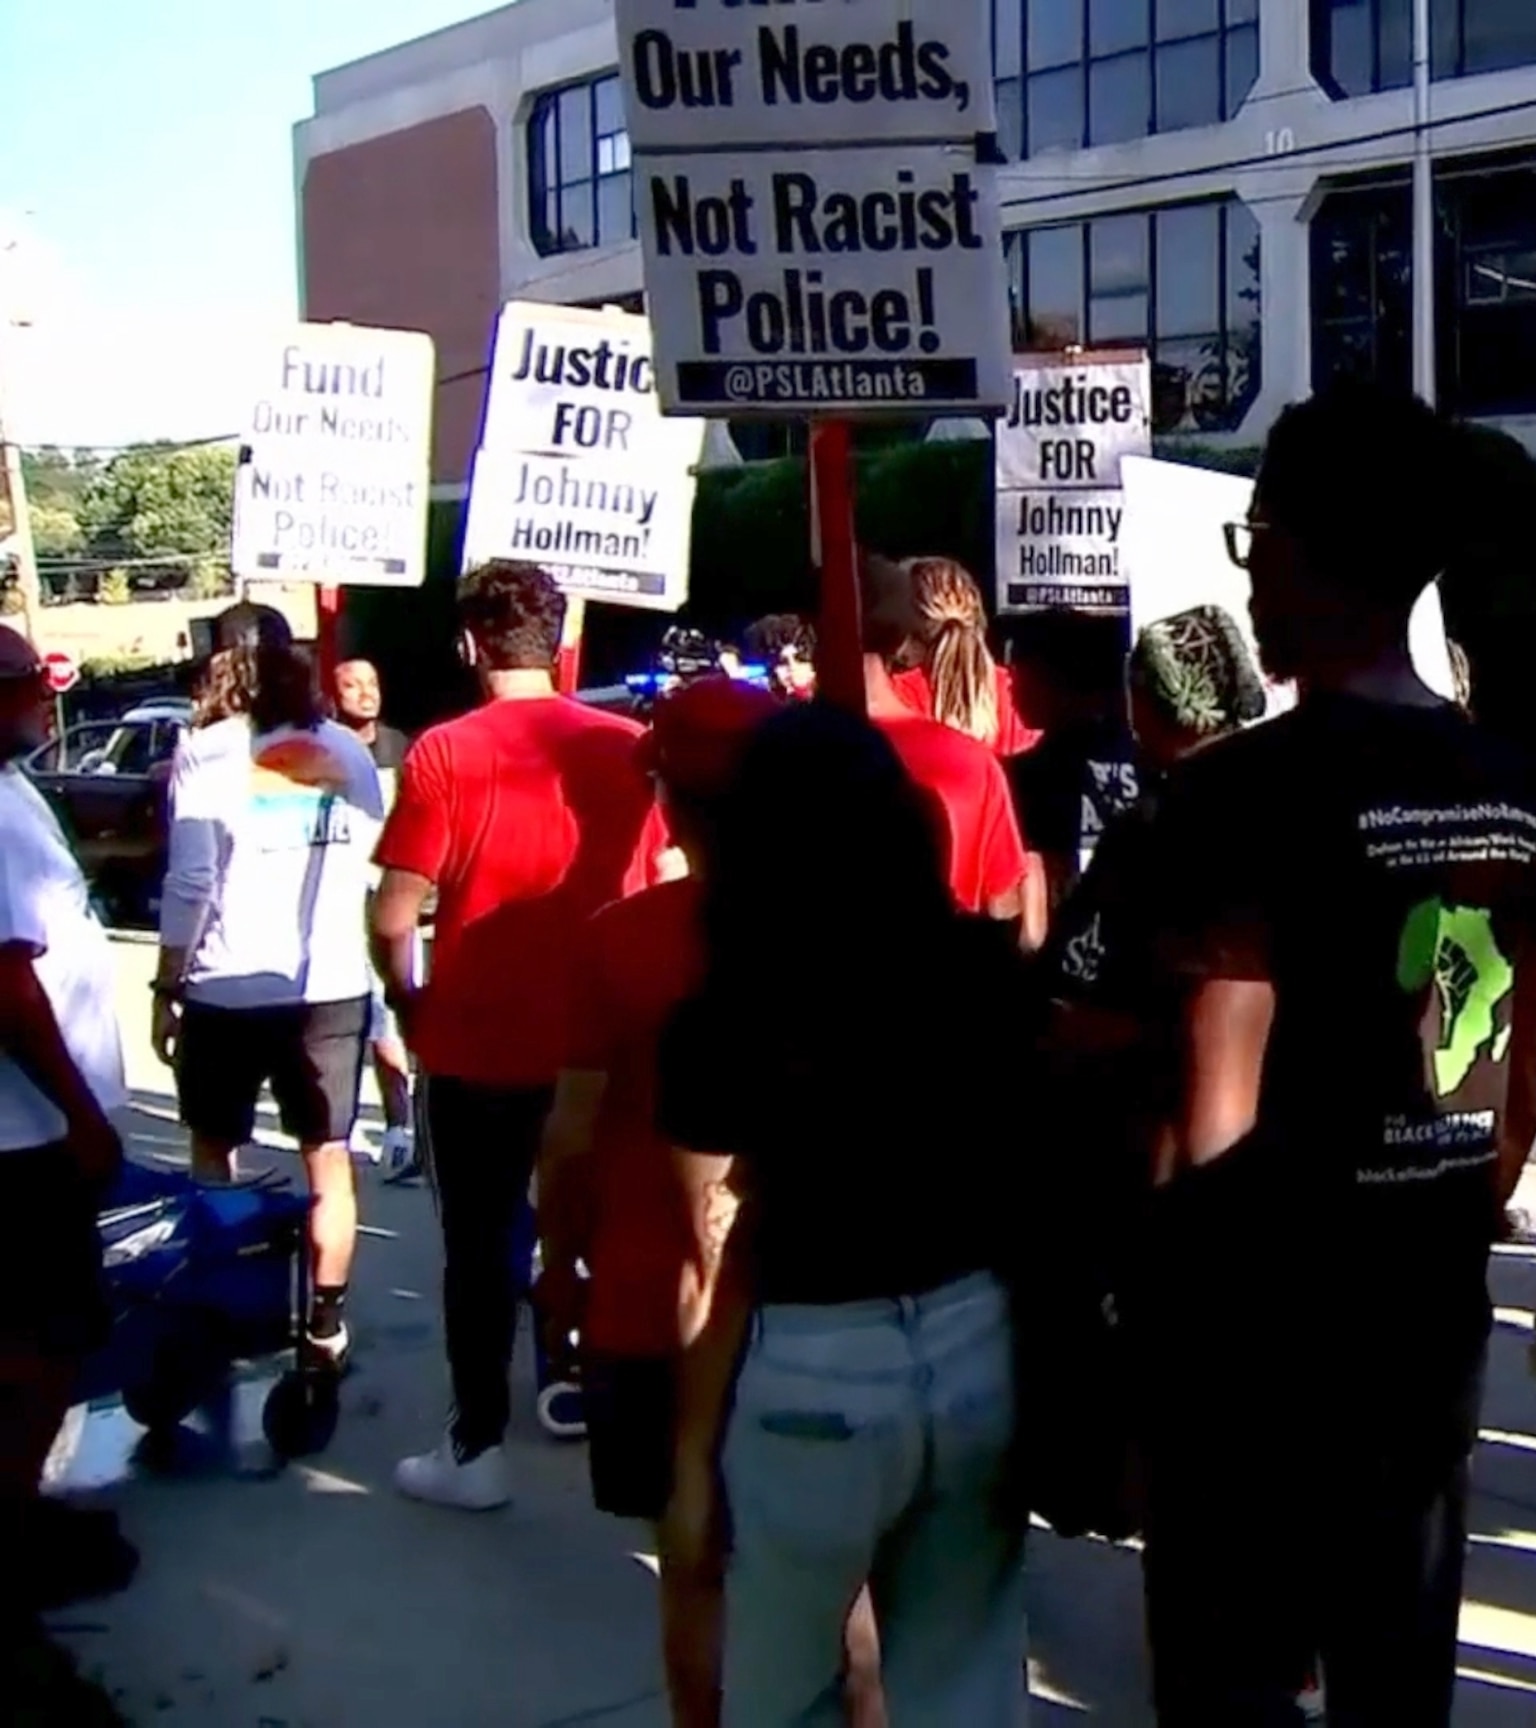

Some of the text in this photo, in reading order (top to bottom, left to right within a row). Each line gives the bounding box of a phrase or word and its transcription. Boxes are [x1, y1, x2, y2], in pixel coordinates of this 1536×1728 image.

[633, 20, 969, 112] Our Needs,
[651, 171, 982, 257] Not Racist
[698, 267, 940, 355] Police!
[282, 345, 385, 398] Fund
[512, 328, 653, 394] Justic
[725, 364, 925, 398] @PSLAtlanta
[253, 401, 309, 434] Our
[1007, 375, 1132, 428] Justice
[552, 402, 632, 450] FOR
[1040, 439, 1096, 480] FOR
[252, 467, 304, 502] Not
[515, 463, 658, 524] Johnny
[511, 517, 651, 559] Hollman!
[1017, 496, 1122, 542] Johnny
[1020, 544, 1119, 577] Hollman!
